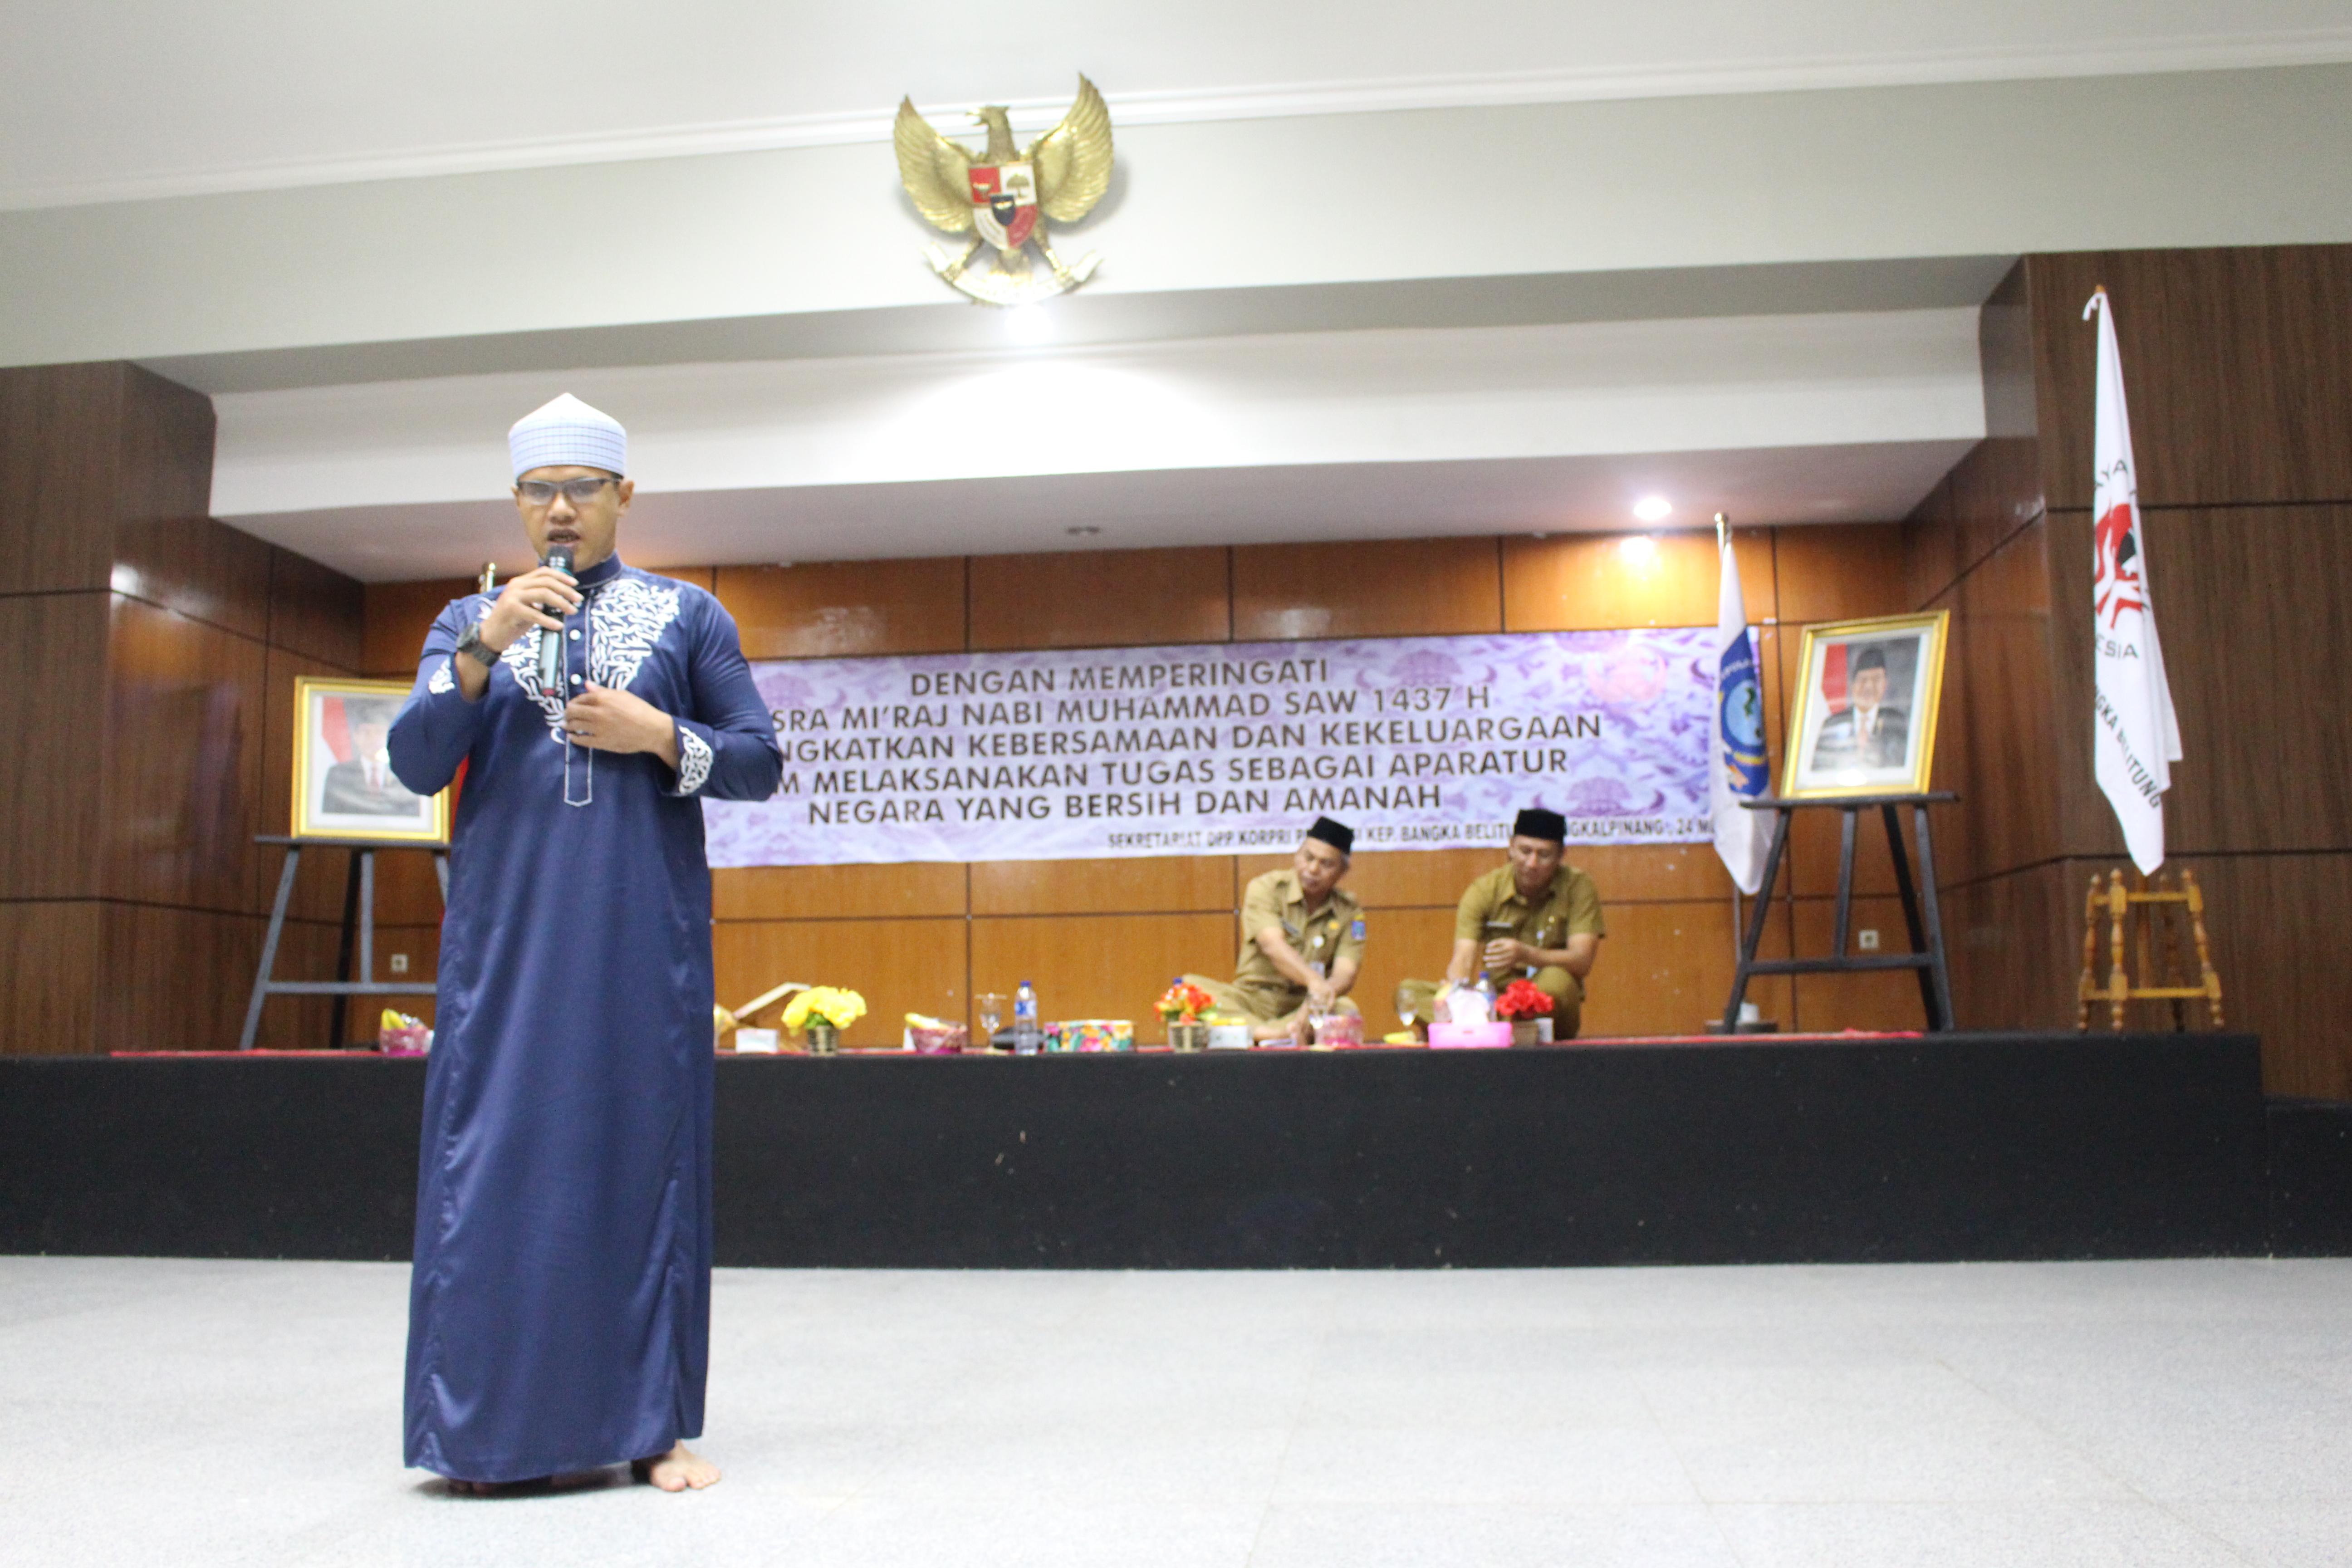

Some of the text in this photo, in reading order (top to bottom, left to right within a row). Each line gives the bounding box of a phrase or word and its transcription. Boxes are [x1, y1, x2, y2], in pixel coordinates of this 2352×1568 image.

[911, 658, 1327, 696] DENGAN MEMPERINGATI
[772, 685, 1489, 732] SRA MI'RAJ NABI MUHAMMAD SAW 1437 H
[969, 726, 1217, 757] KEBERSAMAAN
[1232, 724, 1305, 749] DAN
[1321, 715, 1601, 746] KEKELUARGAAN
[813, 764, 1088, 794] MELAKSANAKAN
[1101, 759, 1214, 785] TUGAS
[1229, 754, 1374, 782] SEBAGAI
[1389, 749, 1567, 777] APARATUR
[809, 784, 1441, 825] NEGARA YANG BERSIH DAN AMANAH
[1107, 831, 1201, 849] SEKRETARIAT
[1239, 828, 1291, 846] KORPRI
[1401, 823, 1460, 842] BANGKA
